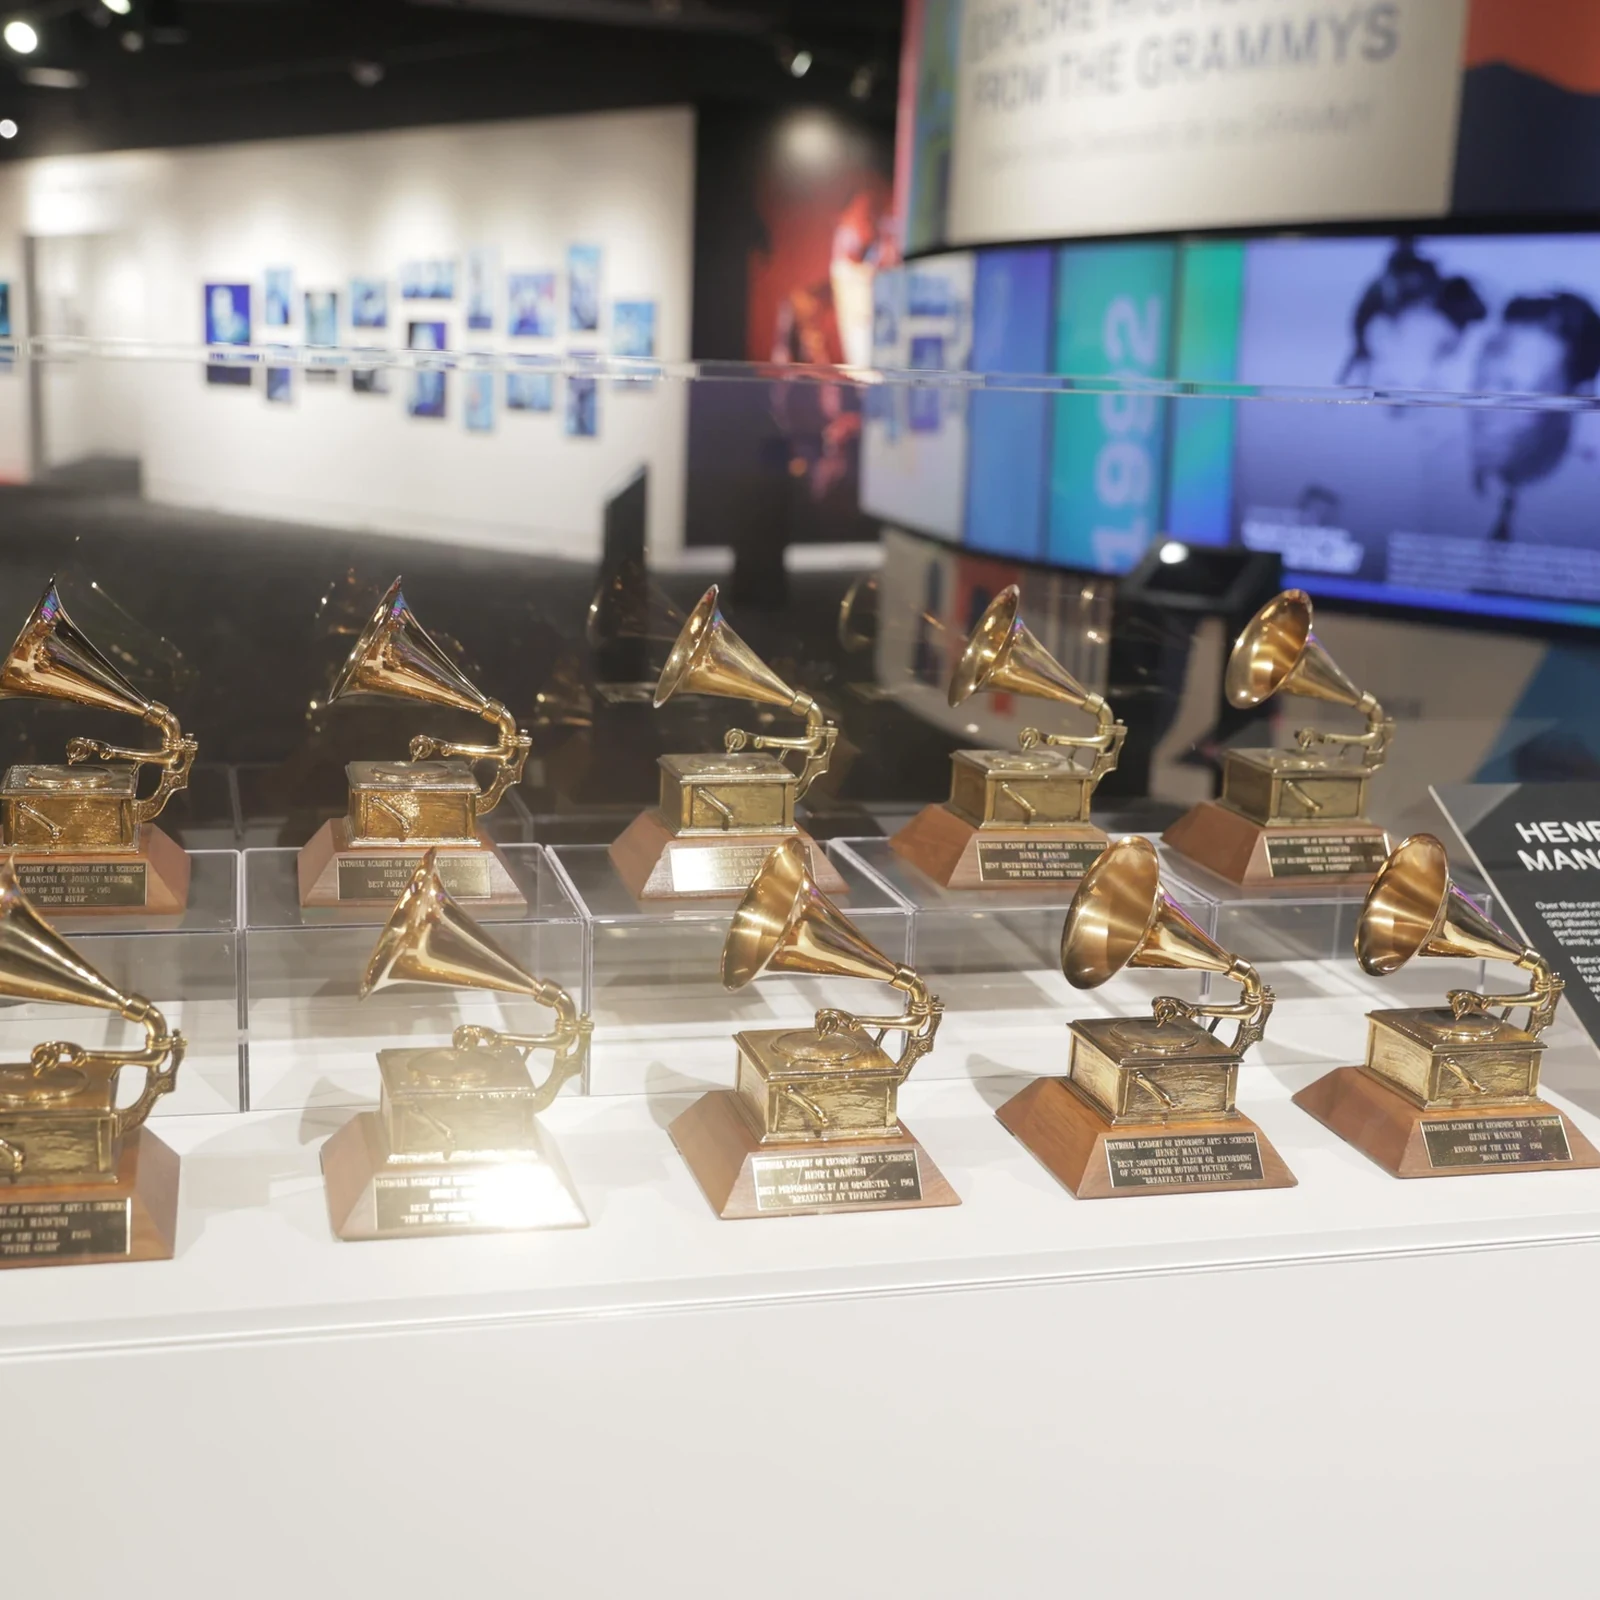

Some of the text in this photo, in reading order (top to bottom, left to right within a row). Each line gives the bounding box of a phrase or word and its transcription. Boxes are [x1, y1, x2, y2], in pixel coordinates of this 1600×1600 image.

[972, 3, 1400, 113] FROM THE GRAMMYS
[1091, 295, 1163, 570] 1992
[1517, 848, 1600, 871] MAN
[1155, 1147, 1212, 1157] HENRY MANCINI
